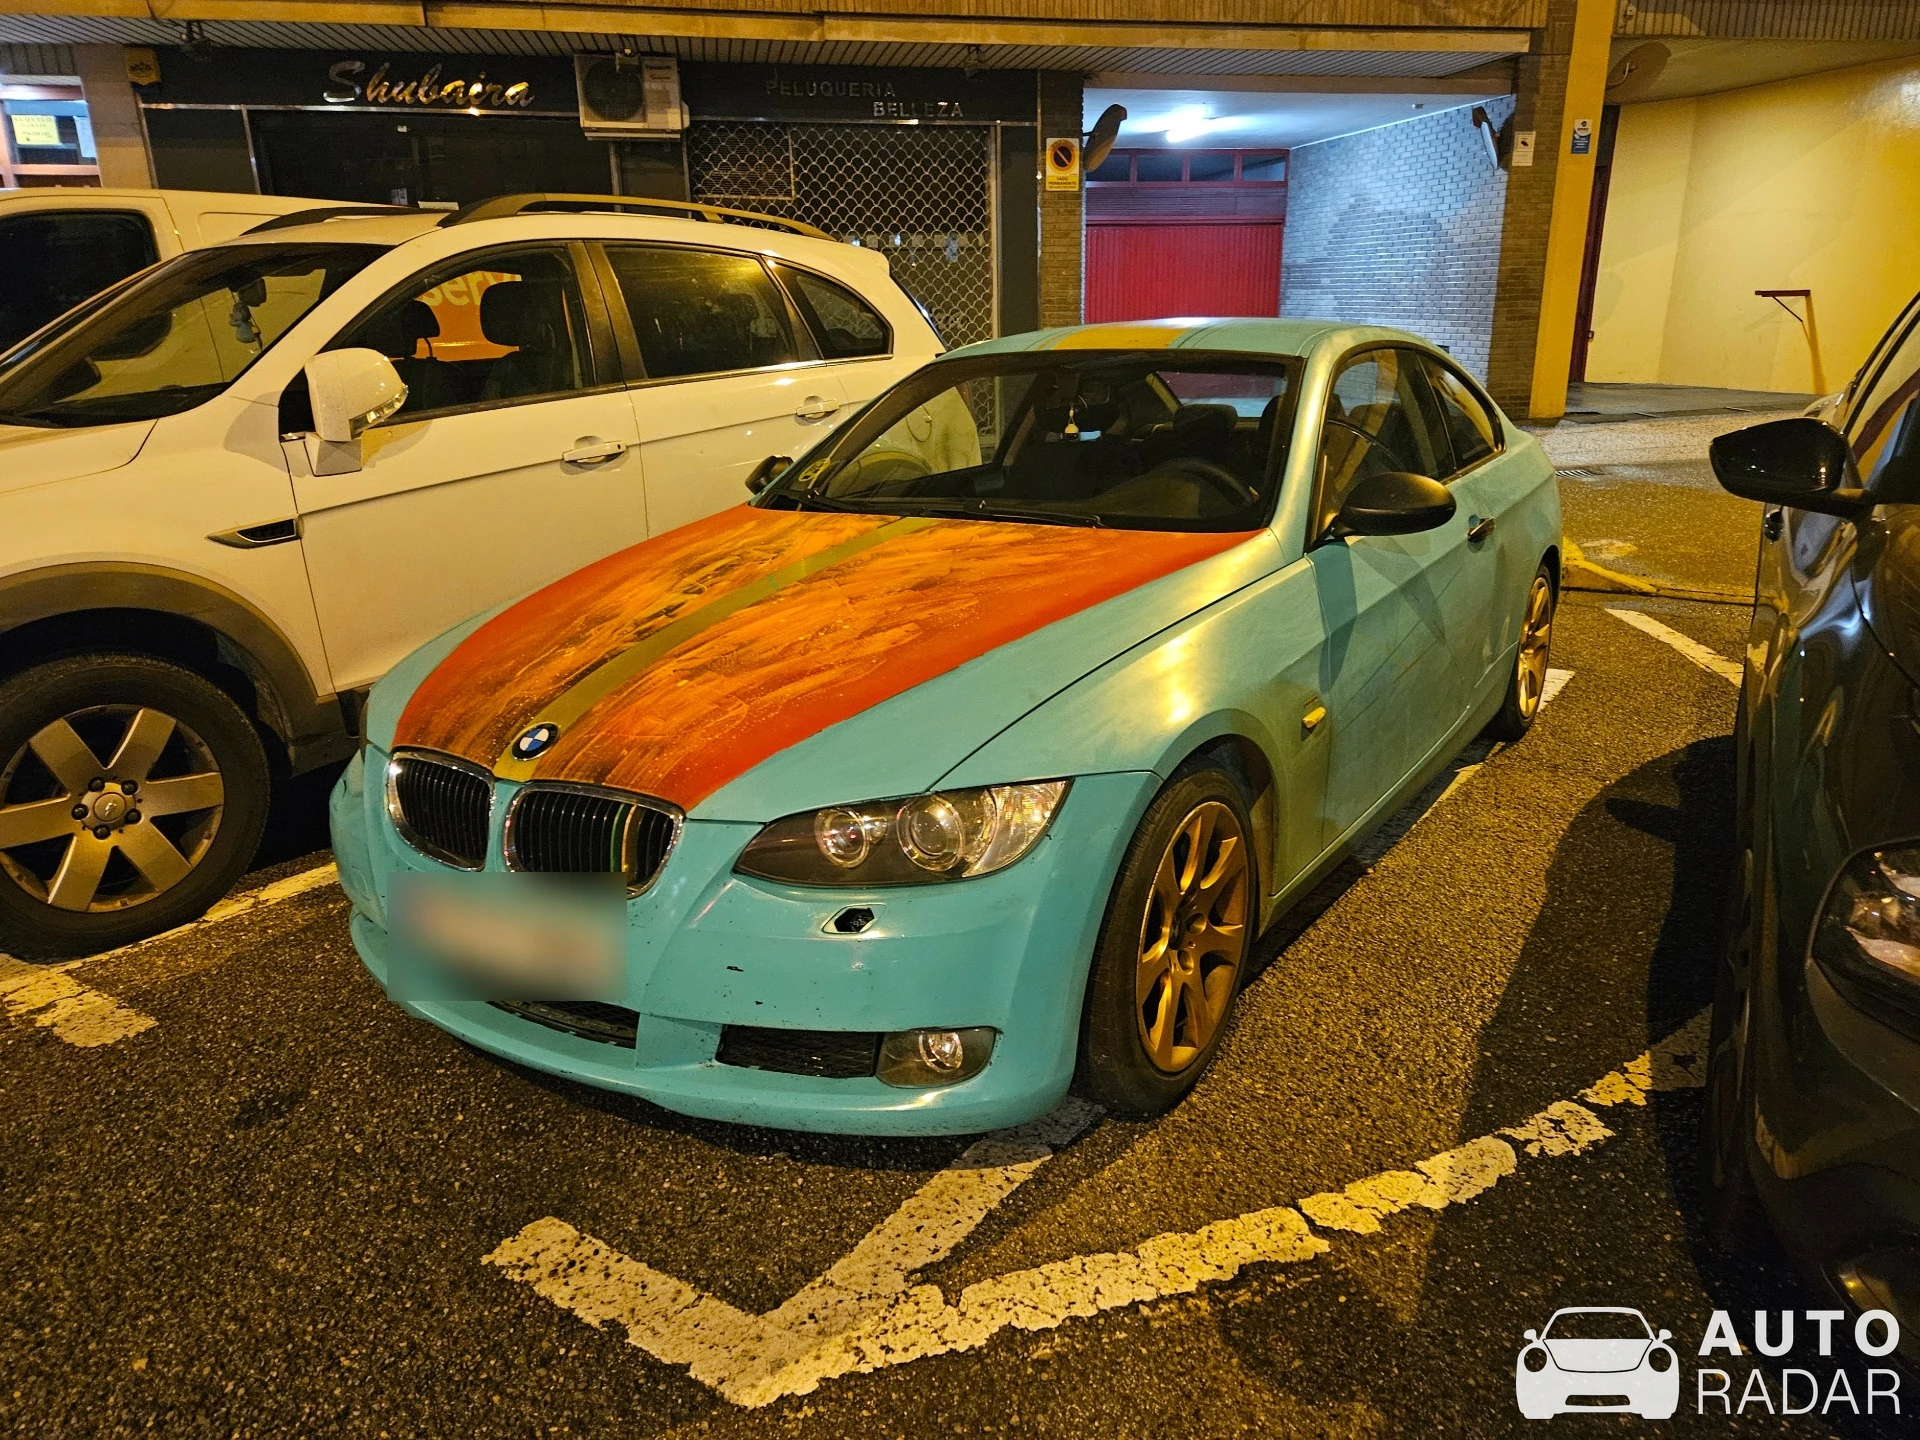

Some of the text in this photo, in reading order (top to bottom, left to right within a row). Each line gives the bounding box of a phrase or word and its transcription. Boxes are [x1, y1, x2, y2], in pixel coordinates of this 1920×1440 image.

[323, 61, 535, 107] Shubaira
[766, 81, 896, 98] PELUQUERIA
[873, 101, 964, 118] BELLEZA
